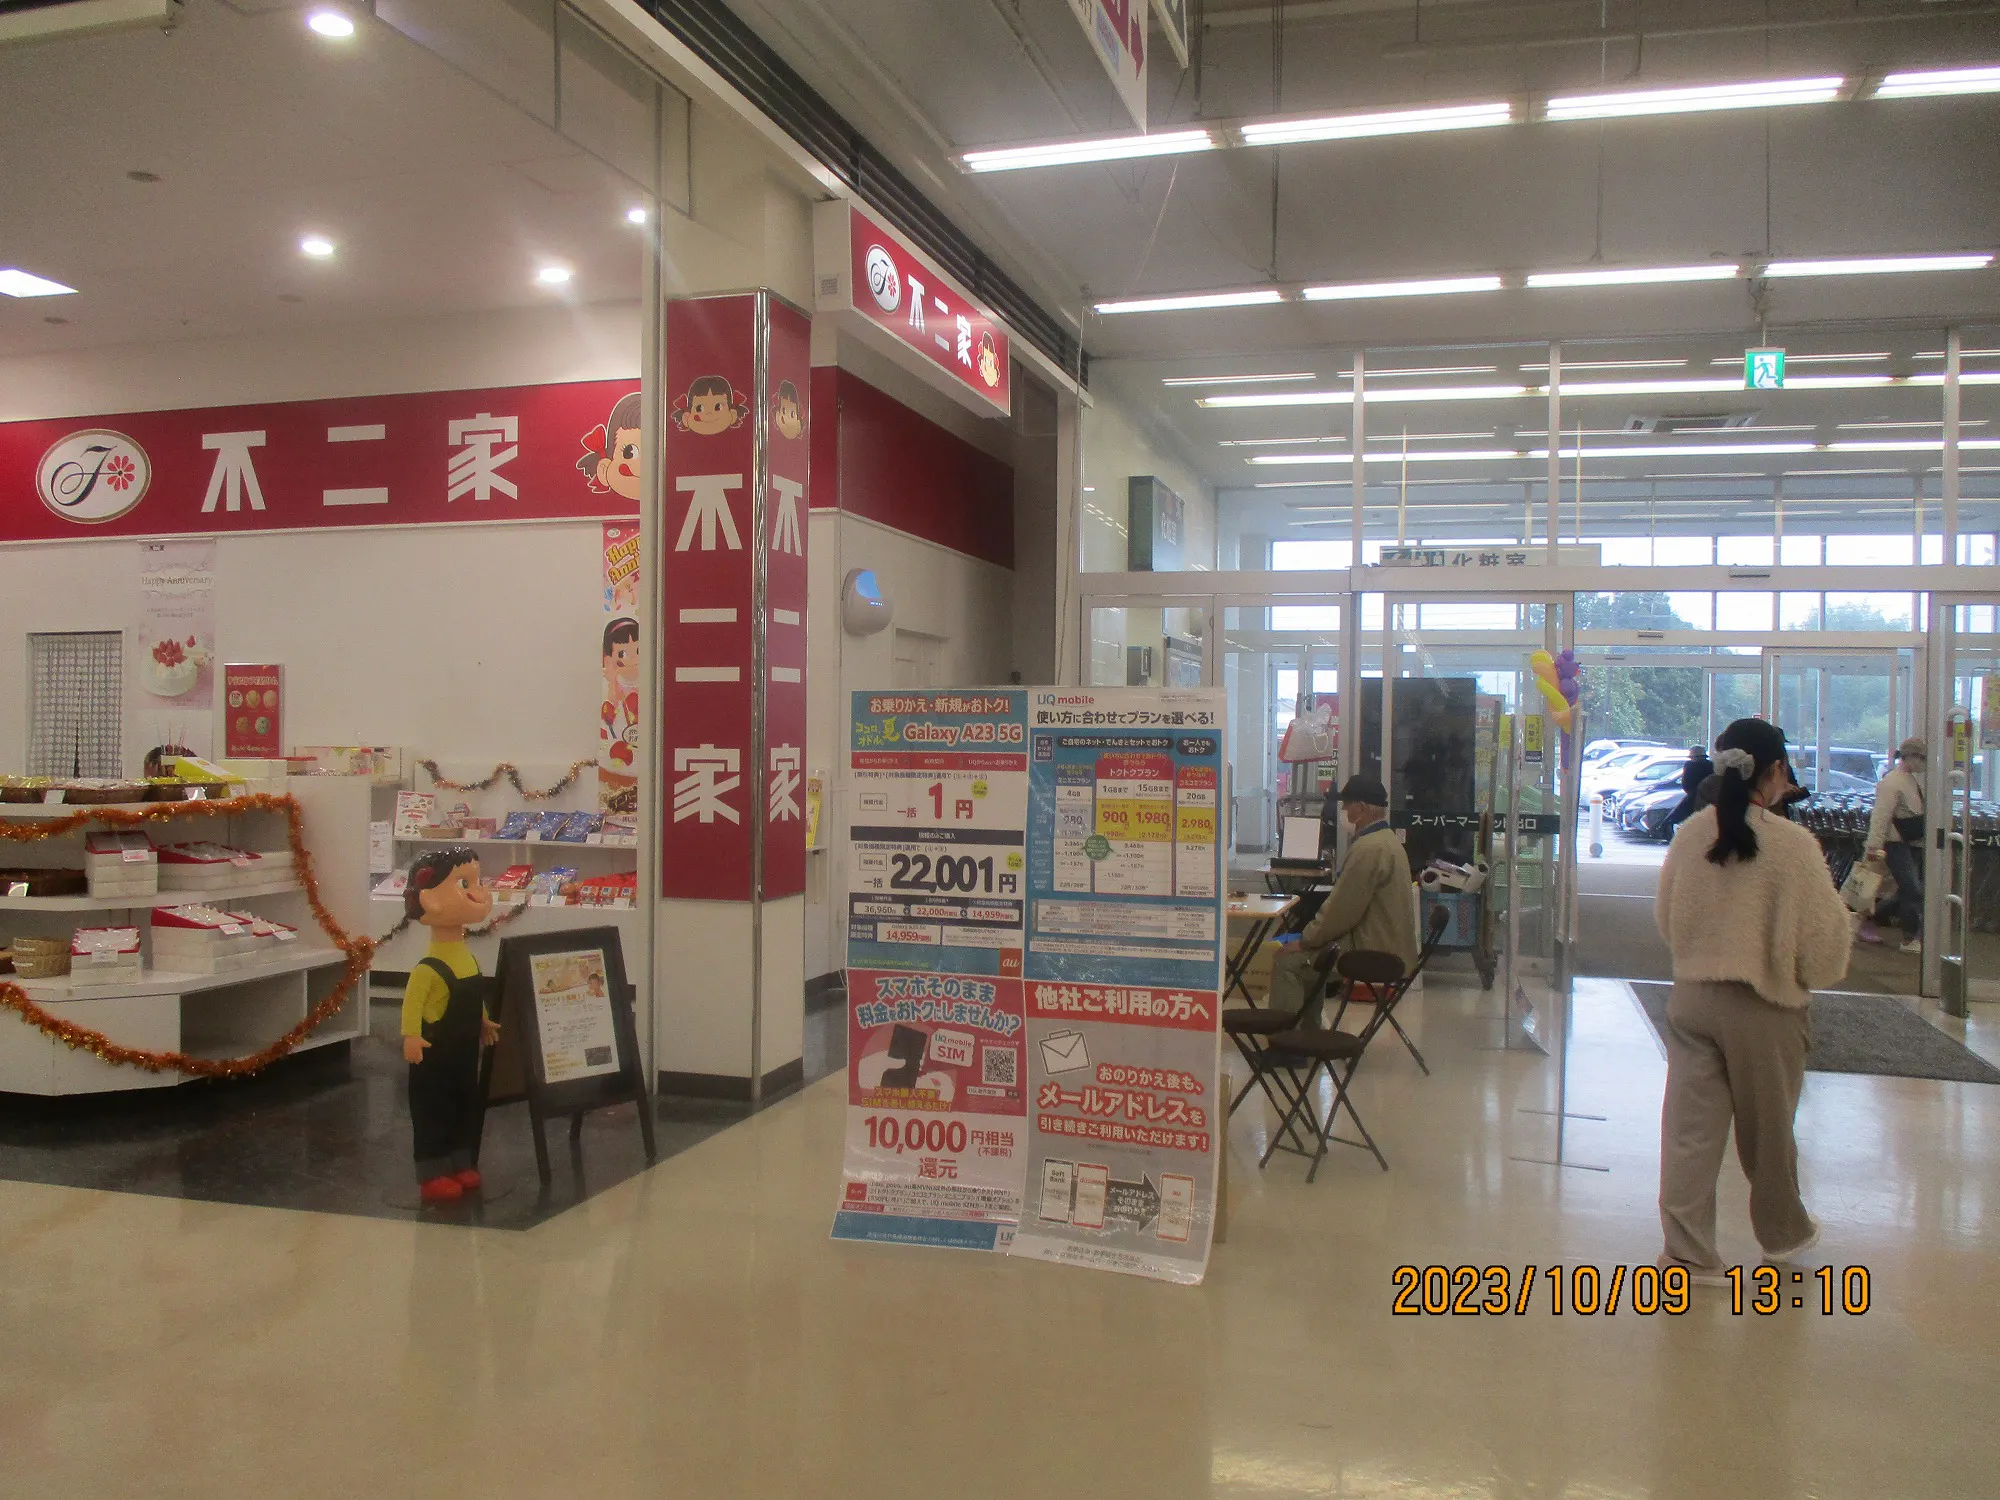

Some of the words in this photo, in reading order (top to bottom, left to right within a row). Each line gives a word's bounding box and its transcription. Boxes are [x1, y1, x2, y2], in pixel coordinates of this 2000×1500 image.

[907, 273, 973, 370] 不二家
[200, 411, 519, 514] 不二家
[142, 576, 165, 587] Happy
[166, 575, 213, 586] Anniversary
[674, 473, 744, 824] 不二家
[770, 477, 803, 824] 不二家
[870, 696, 1010, 714] お乗りかえ・新規がおトク!
[1037, 693, 1056, 706] UQ
[1058, 694, 1095, 705] mobile
[1036, 709, 1215, 726] 使い方に合わせてプランを選べる!
[905, 723, 960, 744] Galaxy
[963, 724, 995, 741] A23
[998, 724, 1023, 742] 5G
[1109, 768, 1160, 777] トクトクプラン
[1102, 784, 1128, 793] 1GBまで
[1138, 784, 1169, 793] 15GBまで
[1186, 792, 1206, 800] 20GB
[897, 807, 917, 818] 一括
[928, 782, 943, 819] 1
[955, 799, 974, 819] 円
[863, 877, 883, 888] 一括
[890, 853, 994, 893] 22,001
[998, 873, 1017, 894] 円
[1002, 957, 1020, 967] au
[876, 977, 995, 1003] スマホそのまま
[1034, 984, 1210, 1021] 他社ご利用の方へ
[934, 1033, 947, 1045] UQ
[947, 1037, 973, 1048] mobile
[937, 1045, 965, 1062] SIM
[1099, 1066, 1203, 1092] おのりかえ後も、
[1039, 1084, 1203, 1126] メールアドレスを
[864, 1115, 968, 1155] 10,000
[970, 1129, 1015, 1148] 円相当
[1040, 1116, 1208, 1149] 引き続きご利用いただけます!
[917, 1156, 958, 1180] 還元
[1051, 1169, 1066, 1177] Soft
[1049, 1176, 1066, 1184] Bank
[1109, 1187, 1156, 1200] メールアドレス
